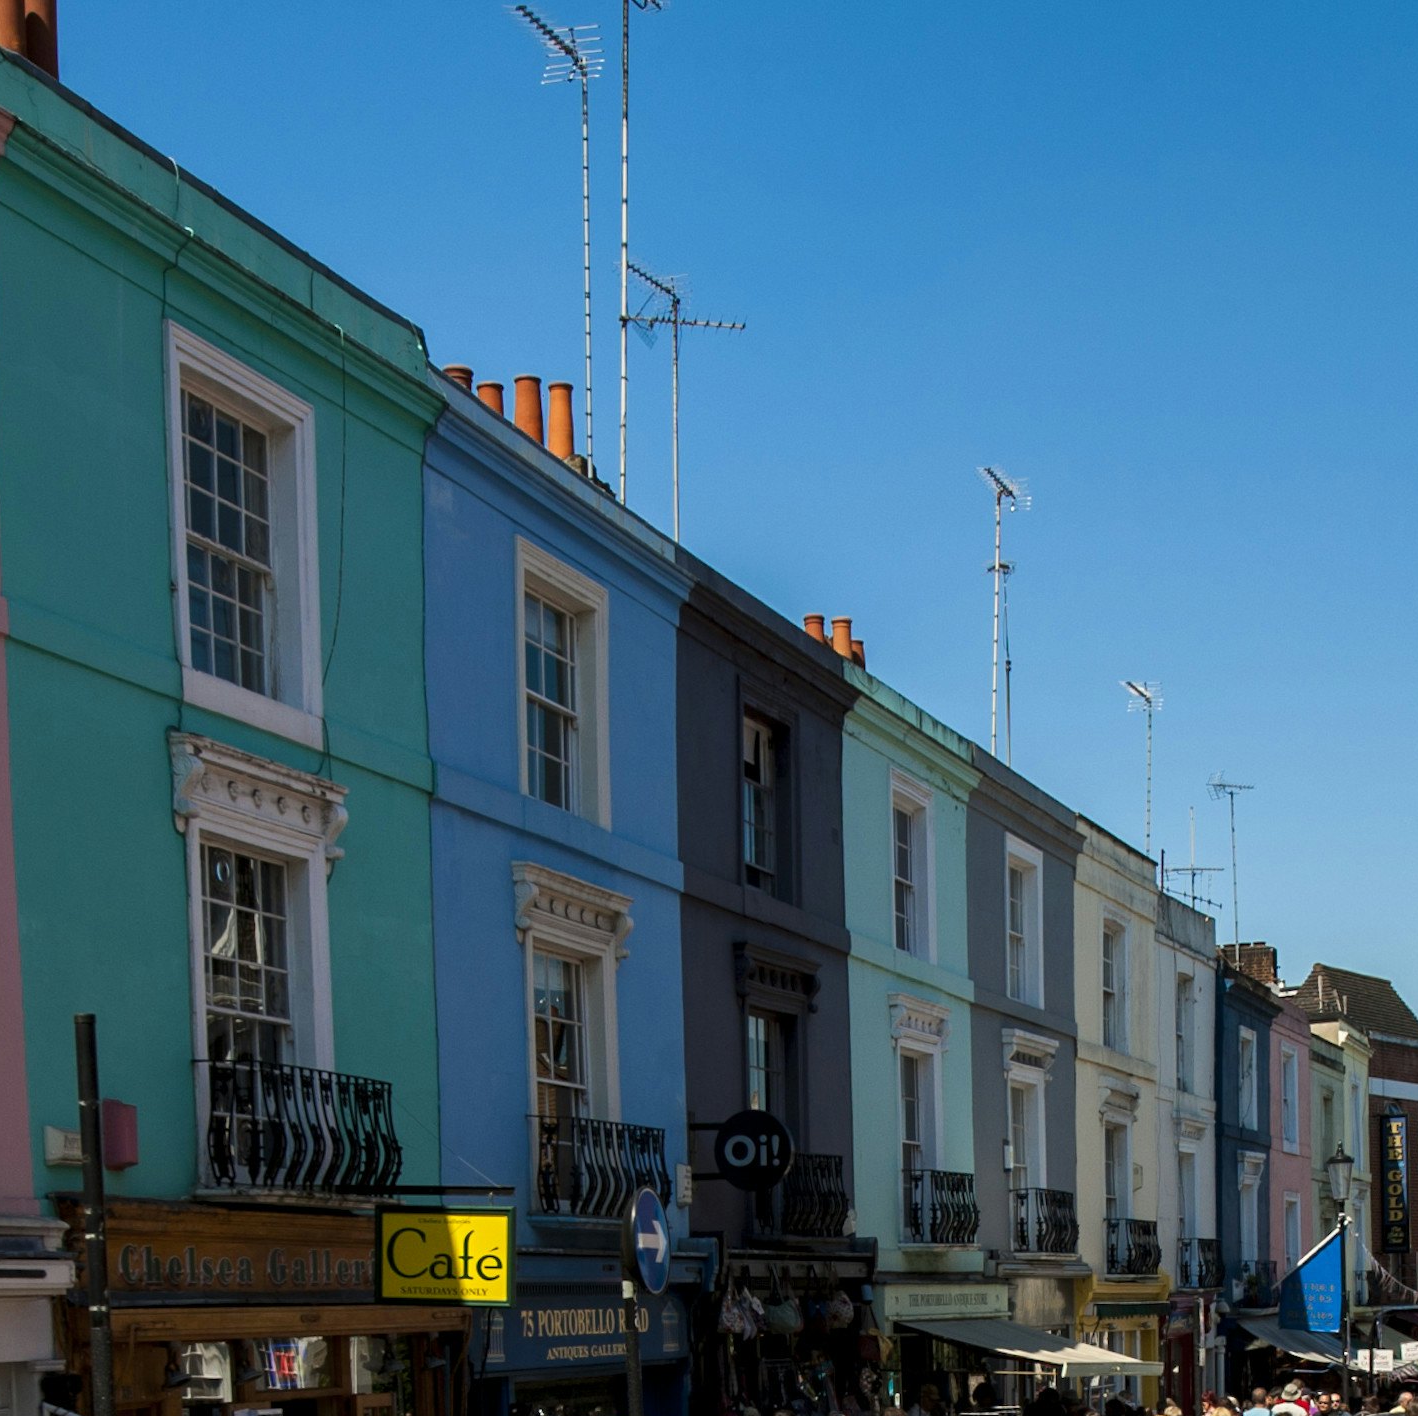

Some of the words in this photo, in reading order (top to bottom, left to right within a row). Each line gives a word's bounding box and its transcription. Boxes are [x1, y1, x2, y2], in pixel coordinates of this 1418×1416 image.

[724, 1133, 781, 1168] Oi!
[1387, 1121, 1403, 1161] THE
[1387, 1169, 1404, 1222] GOLD
[118, 1242, 256, 1287] Chelsea
[266, 1247, 376, 1287] Galleri
[386, 1227, 503, 1281] Café
[400, 1285, 458, 1297] SATURDAYS
[460, 1286, 489, 1297] ONLY
[908, 1294, 920, 1308] THE
[921, 1292, 953, 1307] PORTOBELLO
[973, 1292, 989, 1306] STORE
[520, 1309, 535, 1338] 75
[537, 1307, 617, 1338] PORTOBELLO
[618, 1307, 650, 1333] RAD
[546, 1344, 589, 1362] ANTIQUES
